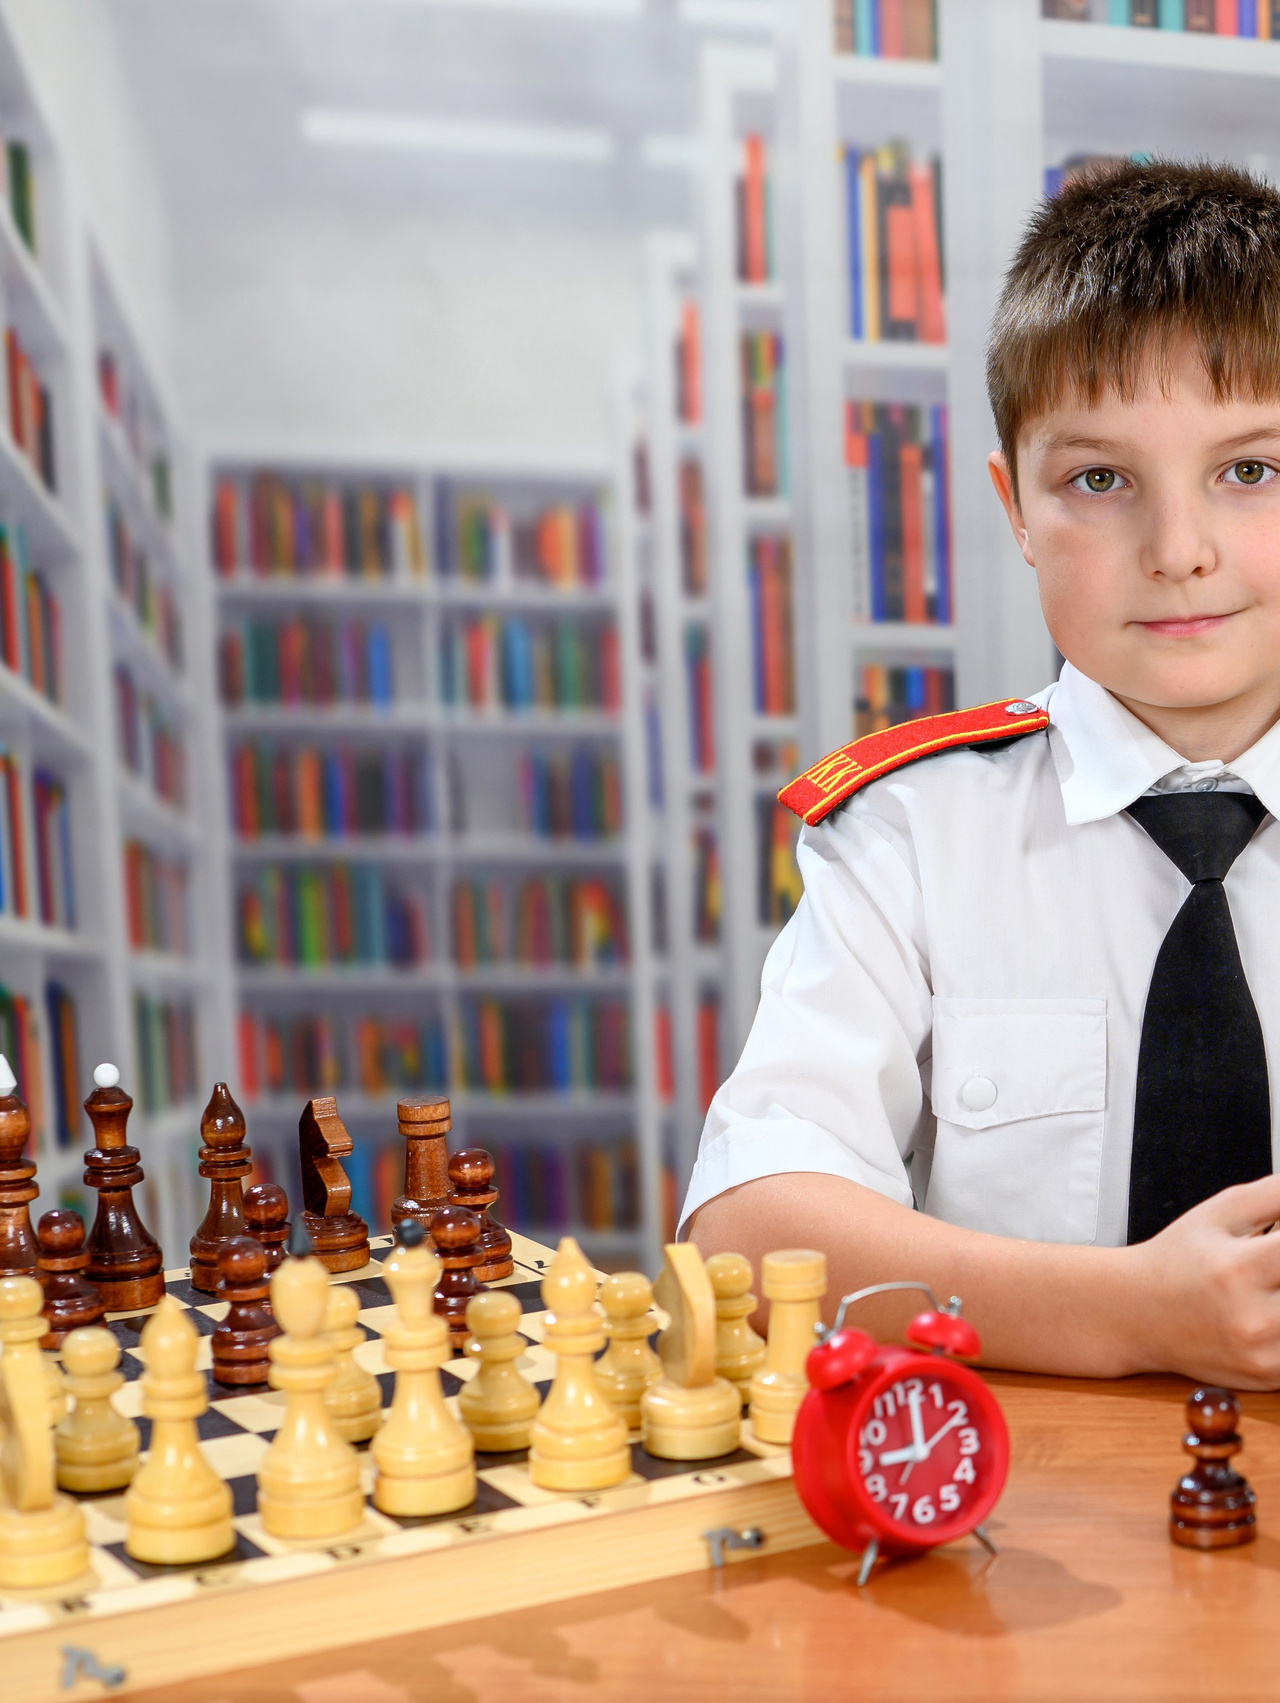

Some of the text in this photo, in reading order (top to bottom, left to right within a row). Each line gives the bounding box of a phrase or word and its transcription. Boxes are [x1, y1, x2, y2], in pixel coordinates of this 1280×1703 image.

[873, 1391, 896, 1418] 11
[892, 1378, 926, 1406] 12
[929, 1382, 944, 1409] 1
[947, 1400, 969, 1426] 2
[958, 1427, 980, 1455] 3
[953, 1456, 977, 1484] 4
[889, 1492, 909, 1520] 7
[912, 1494, 936, 1524] 6
[939, 1483, 961, 1511] 5
